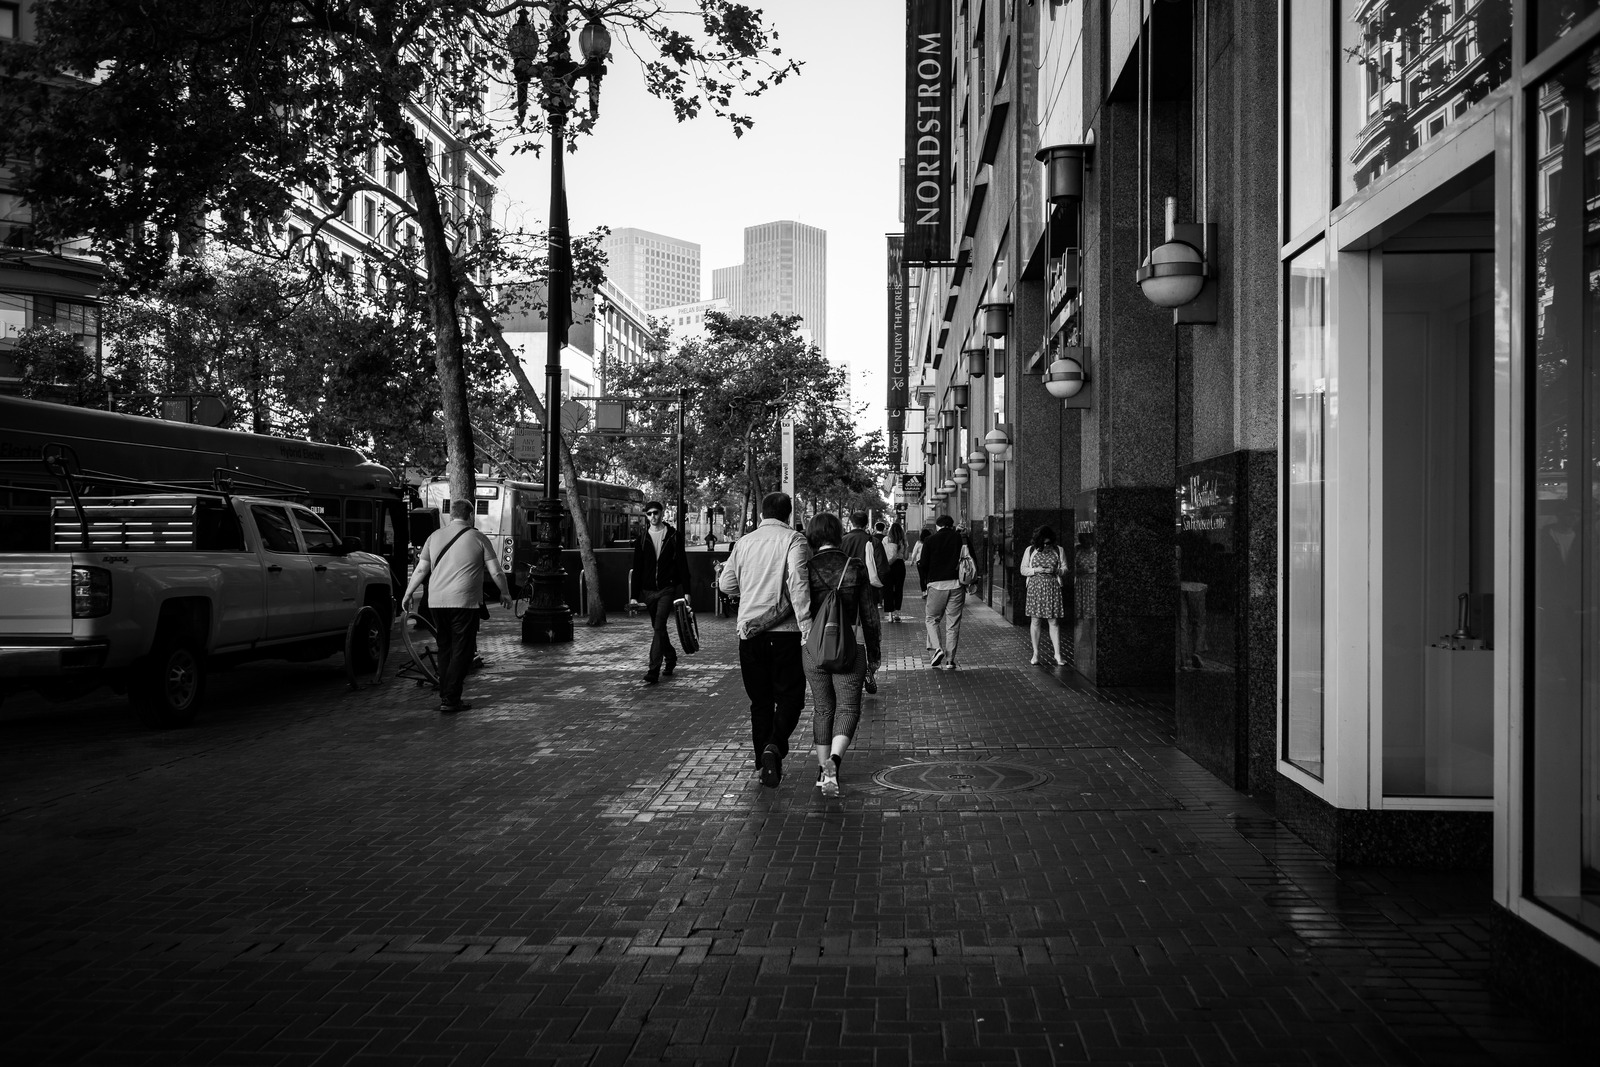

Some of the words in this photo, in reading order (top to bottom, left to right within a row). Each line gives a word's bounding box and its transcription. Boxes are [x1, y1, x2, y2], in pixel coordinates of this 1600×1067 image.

[915, 32, 941, 226] NORDSTROM
[678, 306, 695, 315] PHELAN
[893, 283, 903, 330] THEATRES
[893, 331, 903, 374] CENTURY
[280, 445, 301, 459] Hybrid
[302, 448, 326, 462] Electric
